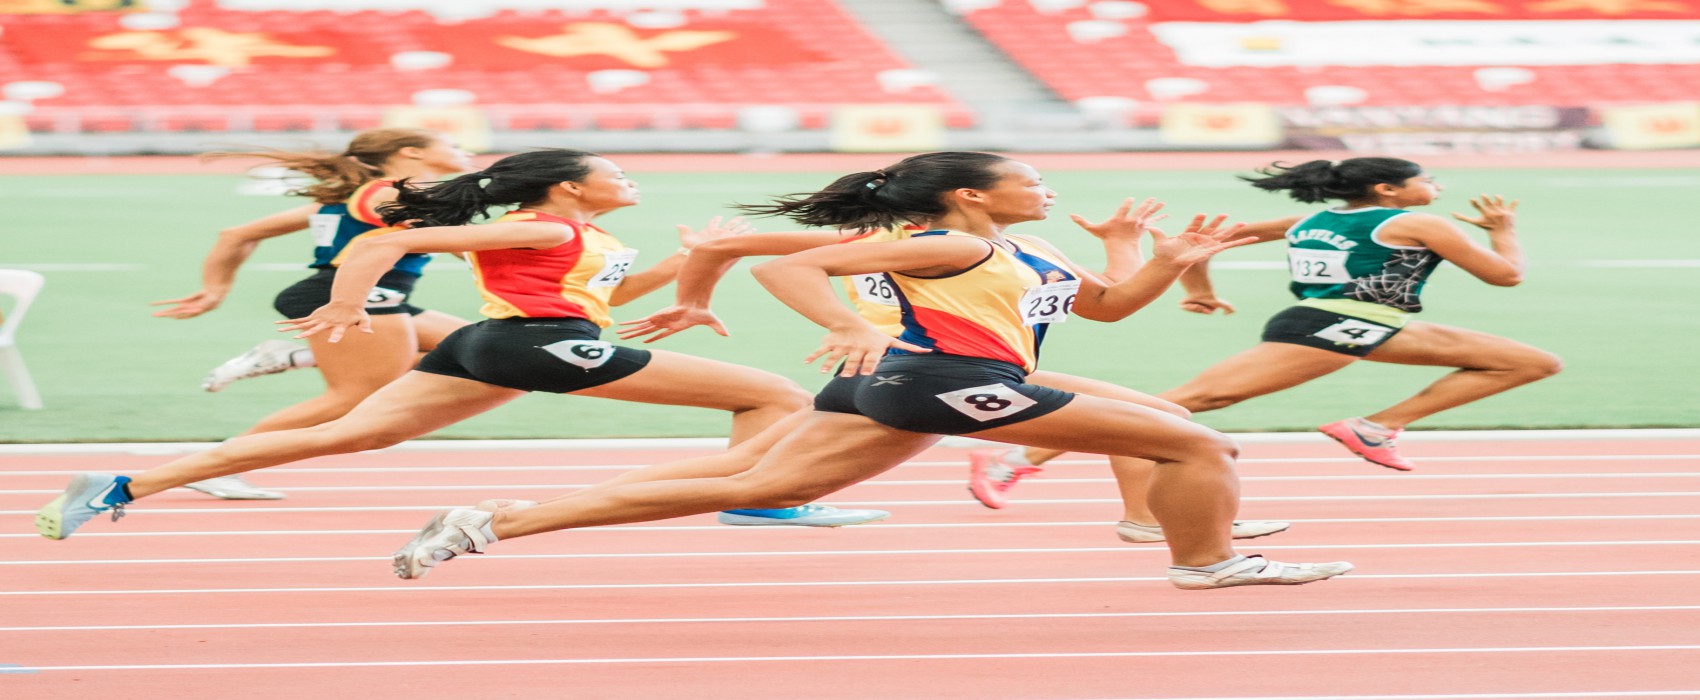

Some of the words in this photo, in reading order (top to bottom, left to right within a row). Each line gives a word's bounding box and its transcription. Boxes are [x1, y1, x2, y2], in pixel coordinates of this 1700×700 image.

[1340, 328, 1370, 339] 4
[571, 344, 603, 360] 6
[964, 393, 1012, 411] 8
